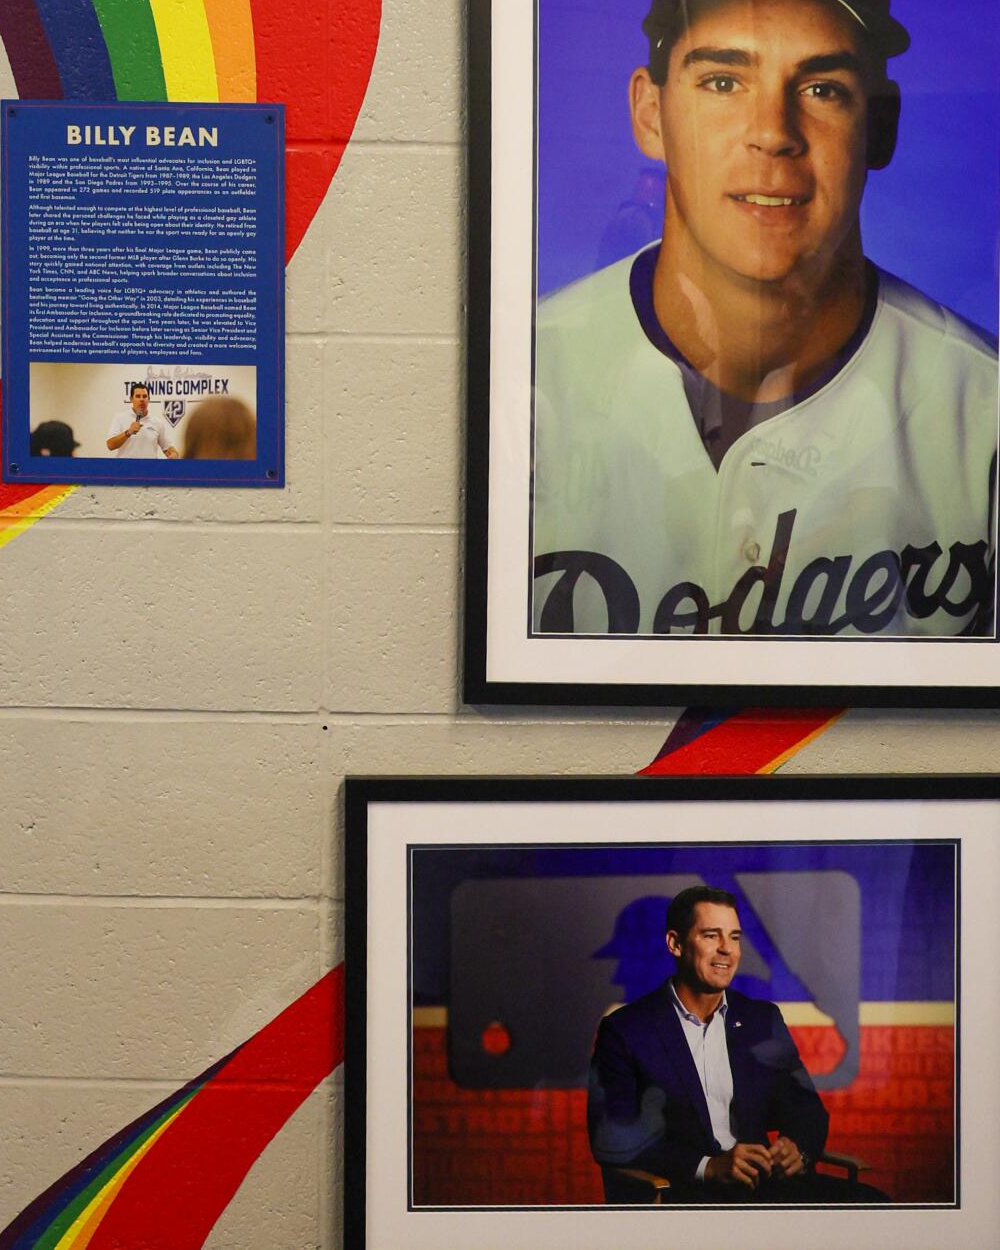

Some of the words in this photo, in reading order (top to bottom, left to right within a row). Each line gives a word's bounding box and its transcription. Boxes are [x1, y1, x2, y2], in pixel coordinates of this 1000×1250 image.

[67, 125, 136, 146] BILLY
[146, 126, 218, 147] BEAN
[28, 155, 40, 163] Billy
[28, 163, 50, 171] visibility
[69, 163, 102, 171] professional
[230, 165, 250, 173] played
[44, 186, 70, 194] appeared
[161, 187, 175, 195] plate
[28, 204, 53, 212] Although
[76, 204, 96, 212] enough
[104, 205, 126, 213] compete
[183, 206, 216, 214] professional
[72, 212, 96, 220] personal
[97, 212, 125, 220] challenges
[167, 213, 188, 221] playing
[74, 286, 95, 294] leading
[148, 287, 174, 295] advocacy
[69, 317, 89, 325] support
[90, 317, 120, 325] throughout
[124, 381, 173, 395] TNING
[175, 379, 229, 395] COMPLEX
[164, 401, 184, 419] 42
[534, 508, 993, 634] Dodgers
